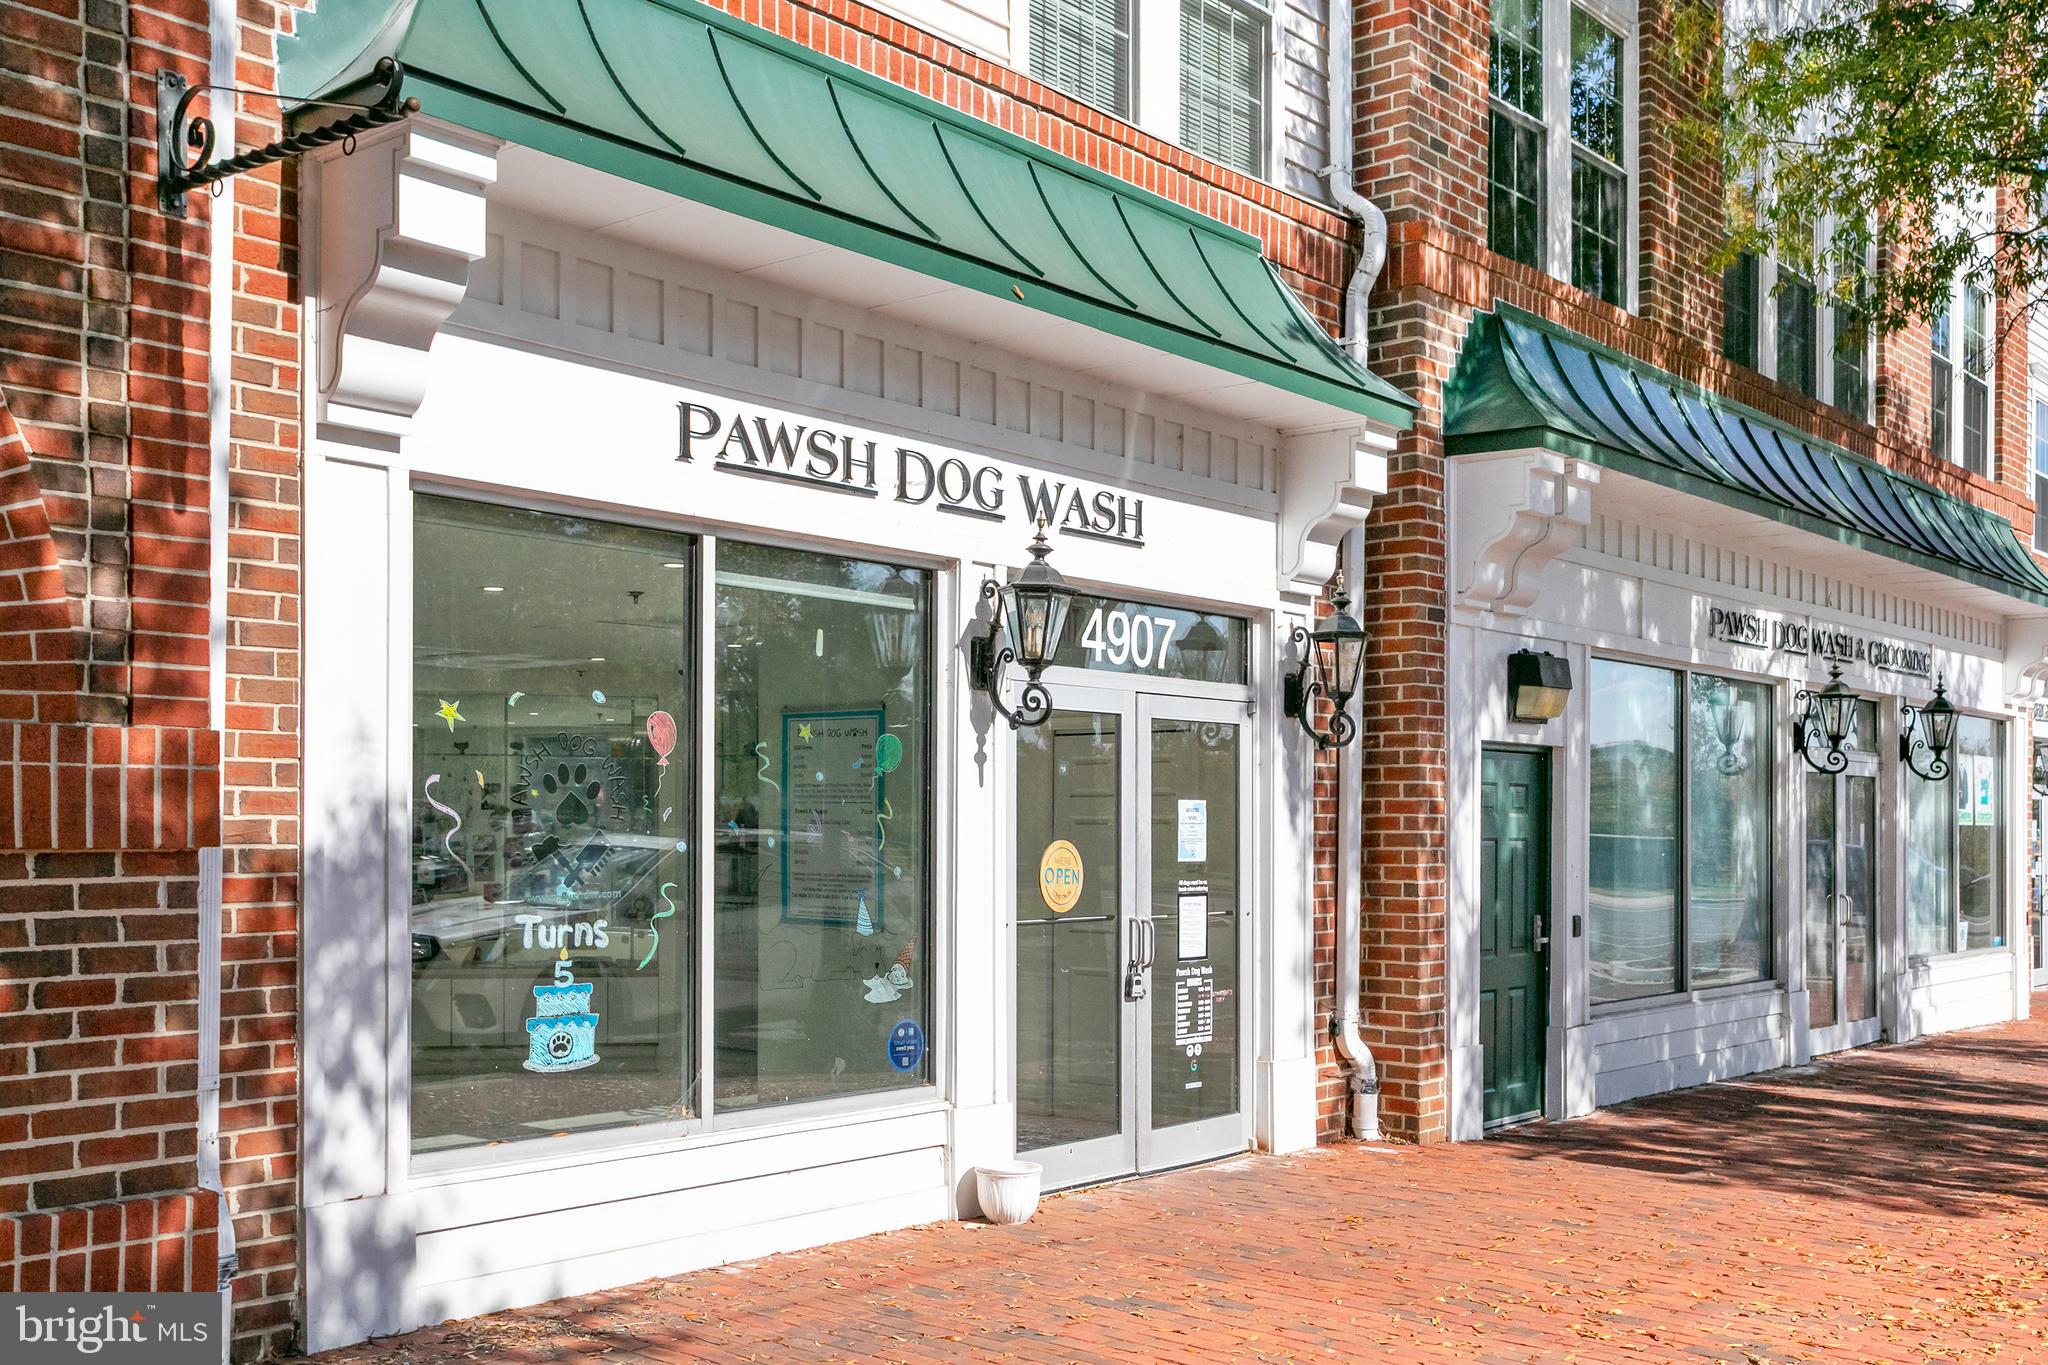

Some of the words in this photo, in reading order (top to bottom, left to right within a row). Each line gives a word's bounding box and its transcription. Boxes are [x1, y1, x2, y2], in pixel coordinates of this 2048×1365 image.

[675, 401, 878, 488] PAWSH
[893, 447, 1005, 512] DOG
[1017, 474, 1144, 539] WASH
[1082, 608, 1177, 669] 4907
[1709, 607, 1768, 644] PAWSH
[1772, 620, 1808, 650] DOG
[1811, 628, 1854, 657] WASH
[1855, 637, 1866, 660] &
[1867, 640, 1931, 674] GROOMING
[511, 741, 552, 822] PAWSH
[557, 731, 598, 755] DOG
[601, 754, 628, 821] WASH
[1044, 867, 1080, 885] OPEN
[514, 914, 610, 949] Turns
[554, 960, 575, 987] 5
